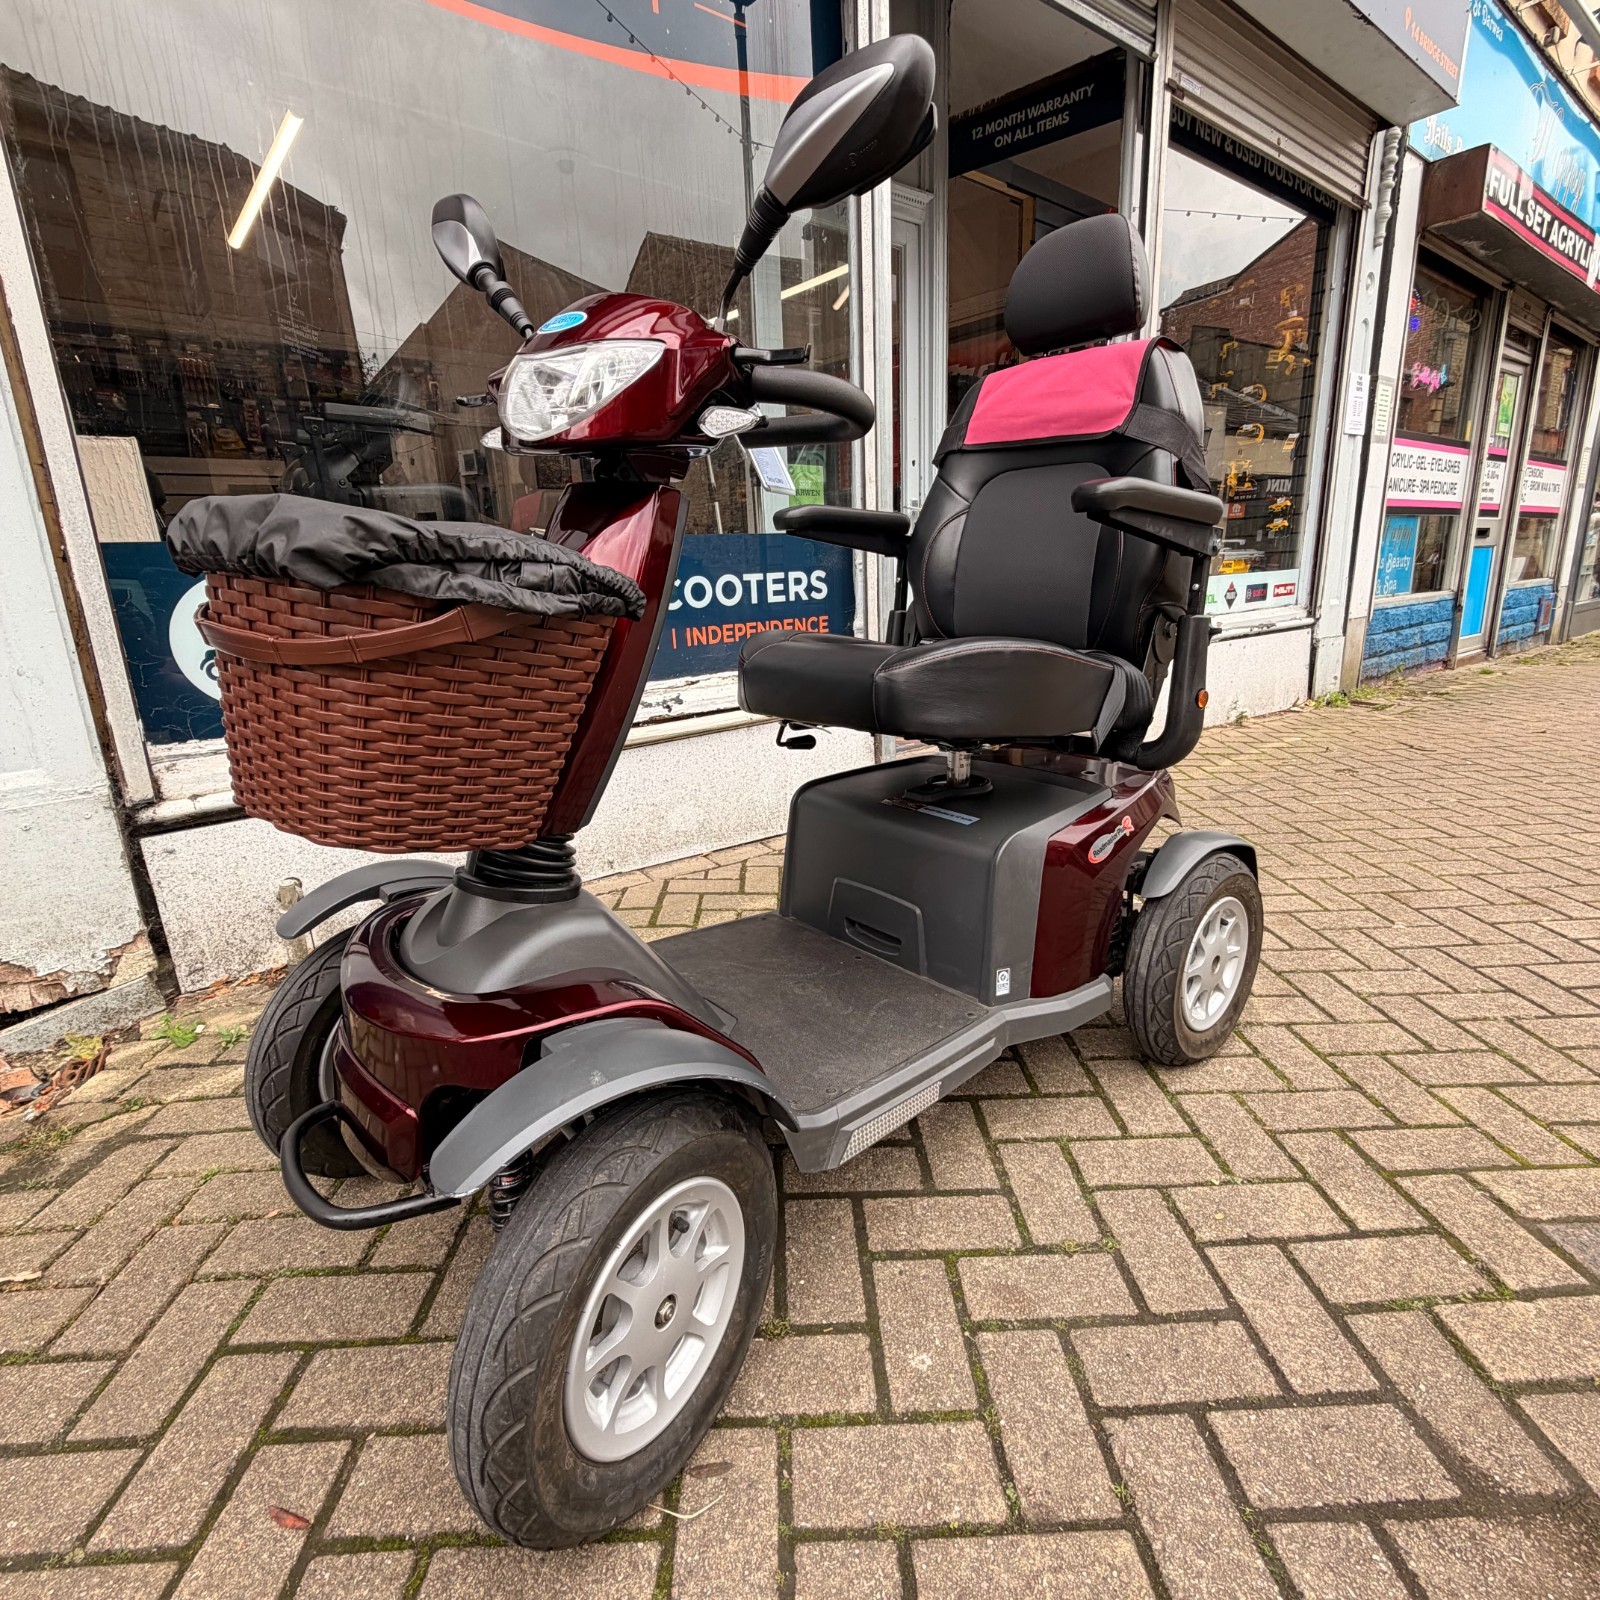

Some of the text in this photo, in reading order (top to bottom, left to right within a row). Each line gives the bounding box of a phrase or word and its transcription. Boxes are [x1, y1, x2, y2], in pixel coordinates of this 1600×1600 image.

[1411, 21, 1459, 80] 14 BRIDGE STREET
[971, 83, 1095, 141] 12 MONTH WARRANTY
[994, 110, 1070, 148] ON ALL ITEMS
[1423, 114, 1453, 155] Nails
[1170, 106, 1336, 212] BUY NEW & USED TOOLS FOR CASH
[1488, 166, 1525, 221] FULL
[1525, 198, 1552, 239] SET
[1430, 480, 1458, 496] PEDICURE
[1385, 553, 1411, 573] Beauty
[1252, 589, 1267, 598] BOSCH
[1274, 585, 1295, 594] HILTI
[1383, 575, 1397, 594] Spa
[685, 615, 829, 647] INDEPENDENCE
